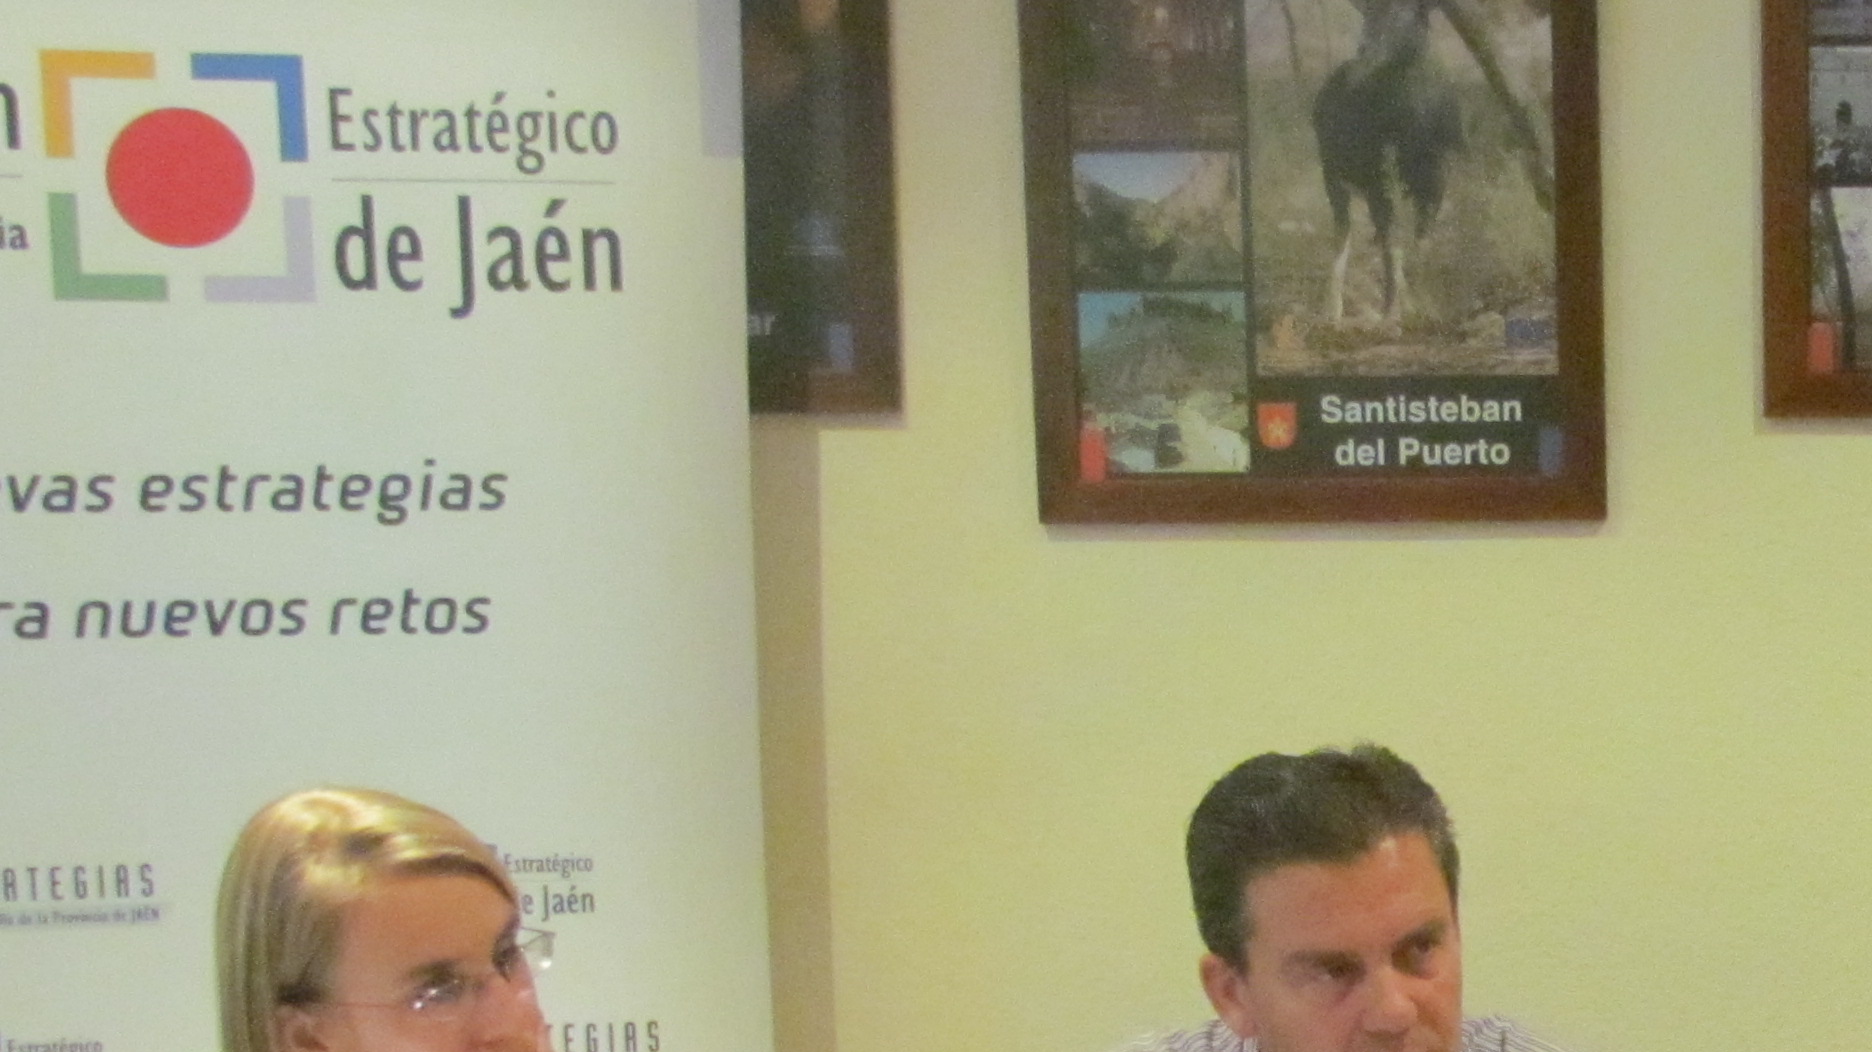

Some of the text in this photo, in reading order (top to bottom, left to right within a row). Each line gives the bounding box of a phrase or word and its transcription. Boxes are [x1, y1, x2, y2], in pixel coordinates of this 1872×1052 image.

[327, 87, 620, 175] Estratégico
[333, 194, 624, 319] de Jaén
[1320, 395, 1523, 424] Santisteban
[1334, 437, 1511, 466] del Puerto
[138, 459, 509, 526] estrategias
[74, 599, 309, 639] nuevos
[329, 589, 492, 635] retos
[503, 852, 595, 878] Estratégico
[540, 884, 595, 922] Jaén
